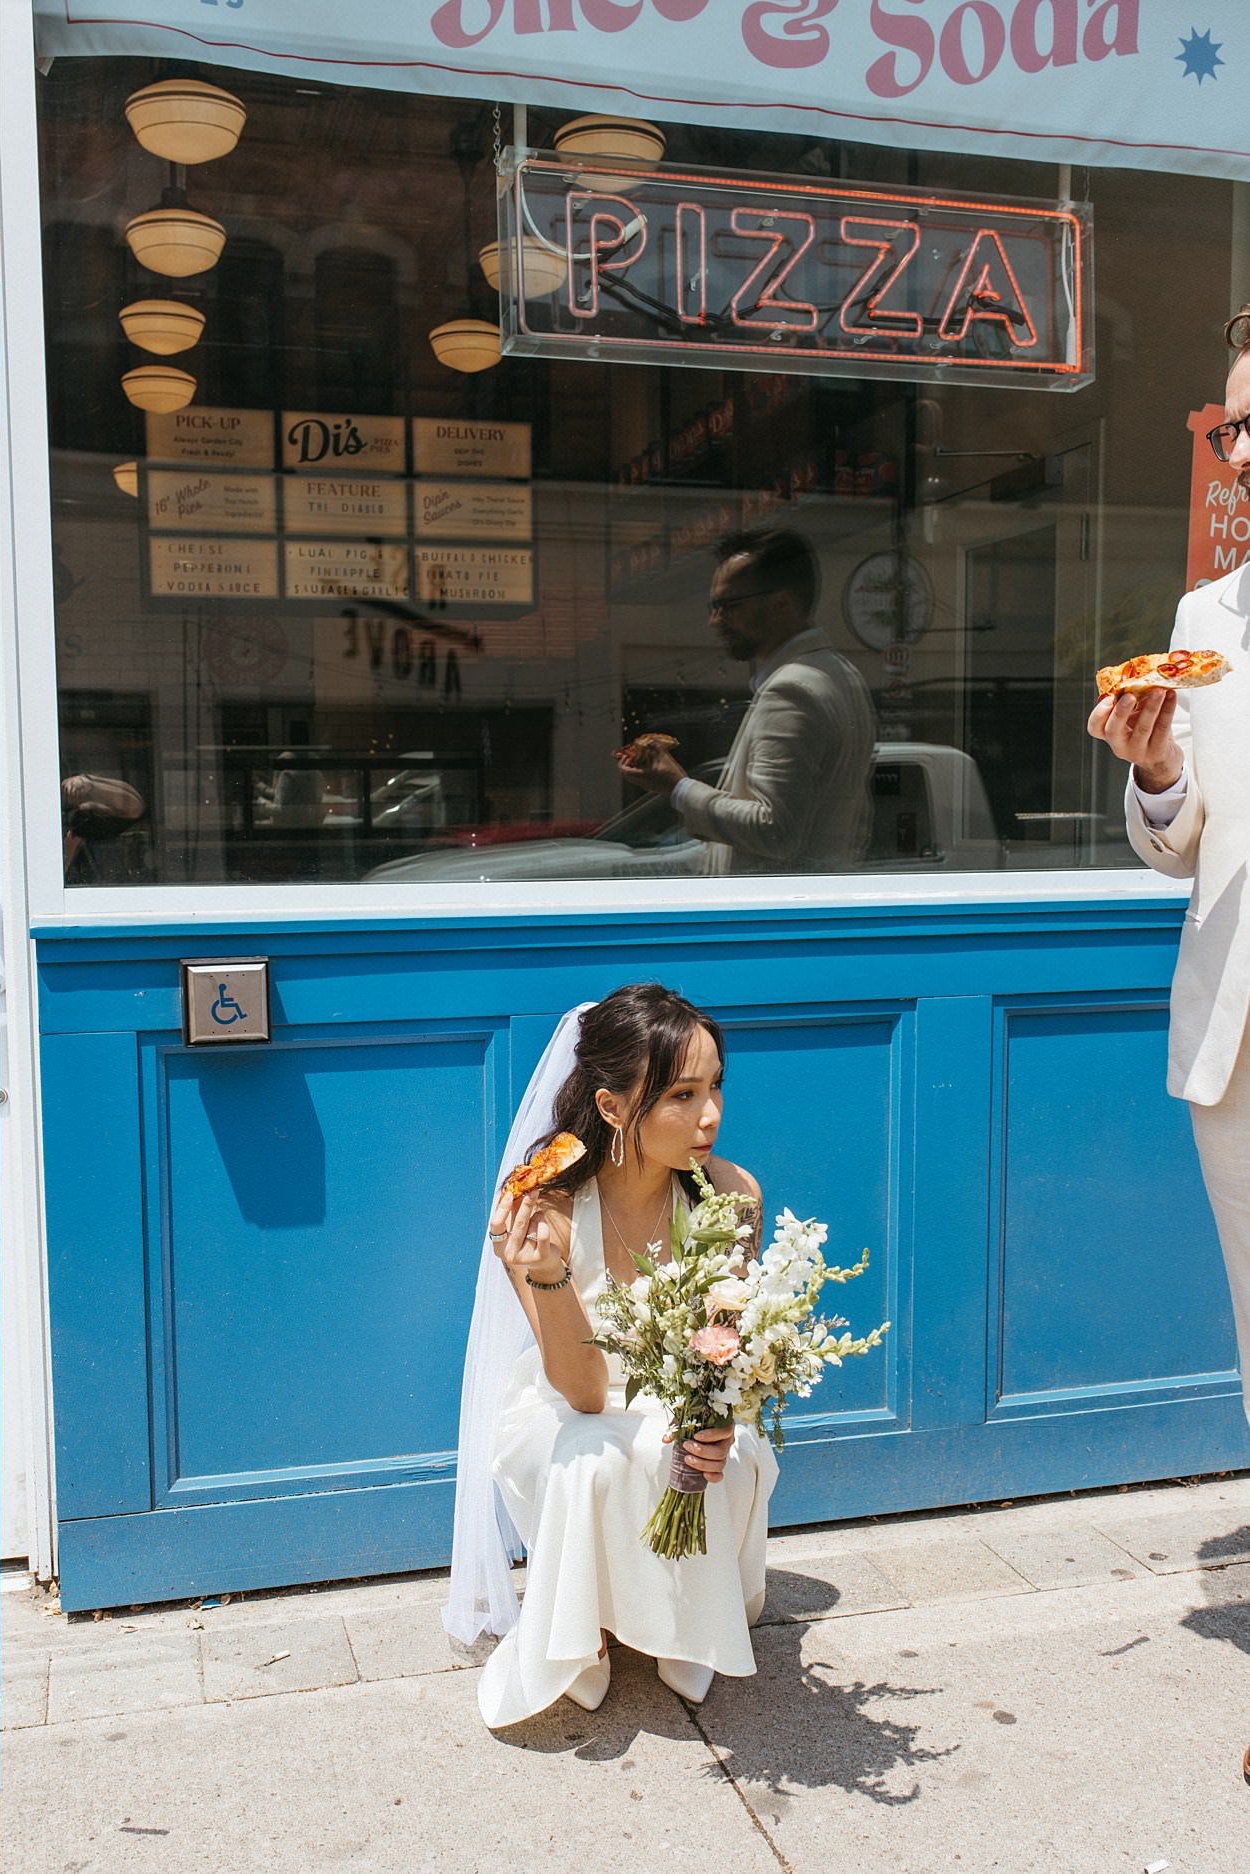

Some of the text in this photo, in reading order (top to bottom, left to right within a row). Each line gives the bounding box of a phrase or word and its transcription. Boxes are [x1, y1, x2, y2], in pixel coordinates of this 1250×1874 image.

[566, 190, 1037, 347] PIZZA
[288, 418, 368, 463] Di's
[436, 426, 507, 441] DELIVERY
[307, 482, 381, 497] FEATURE
